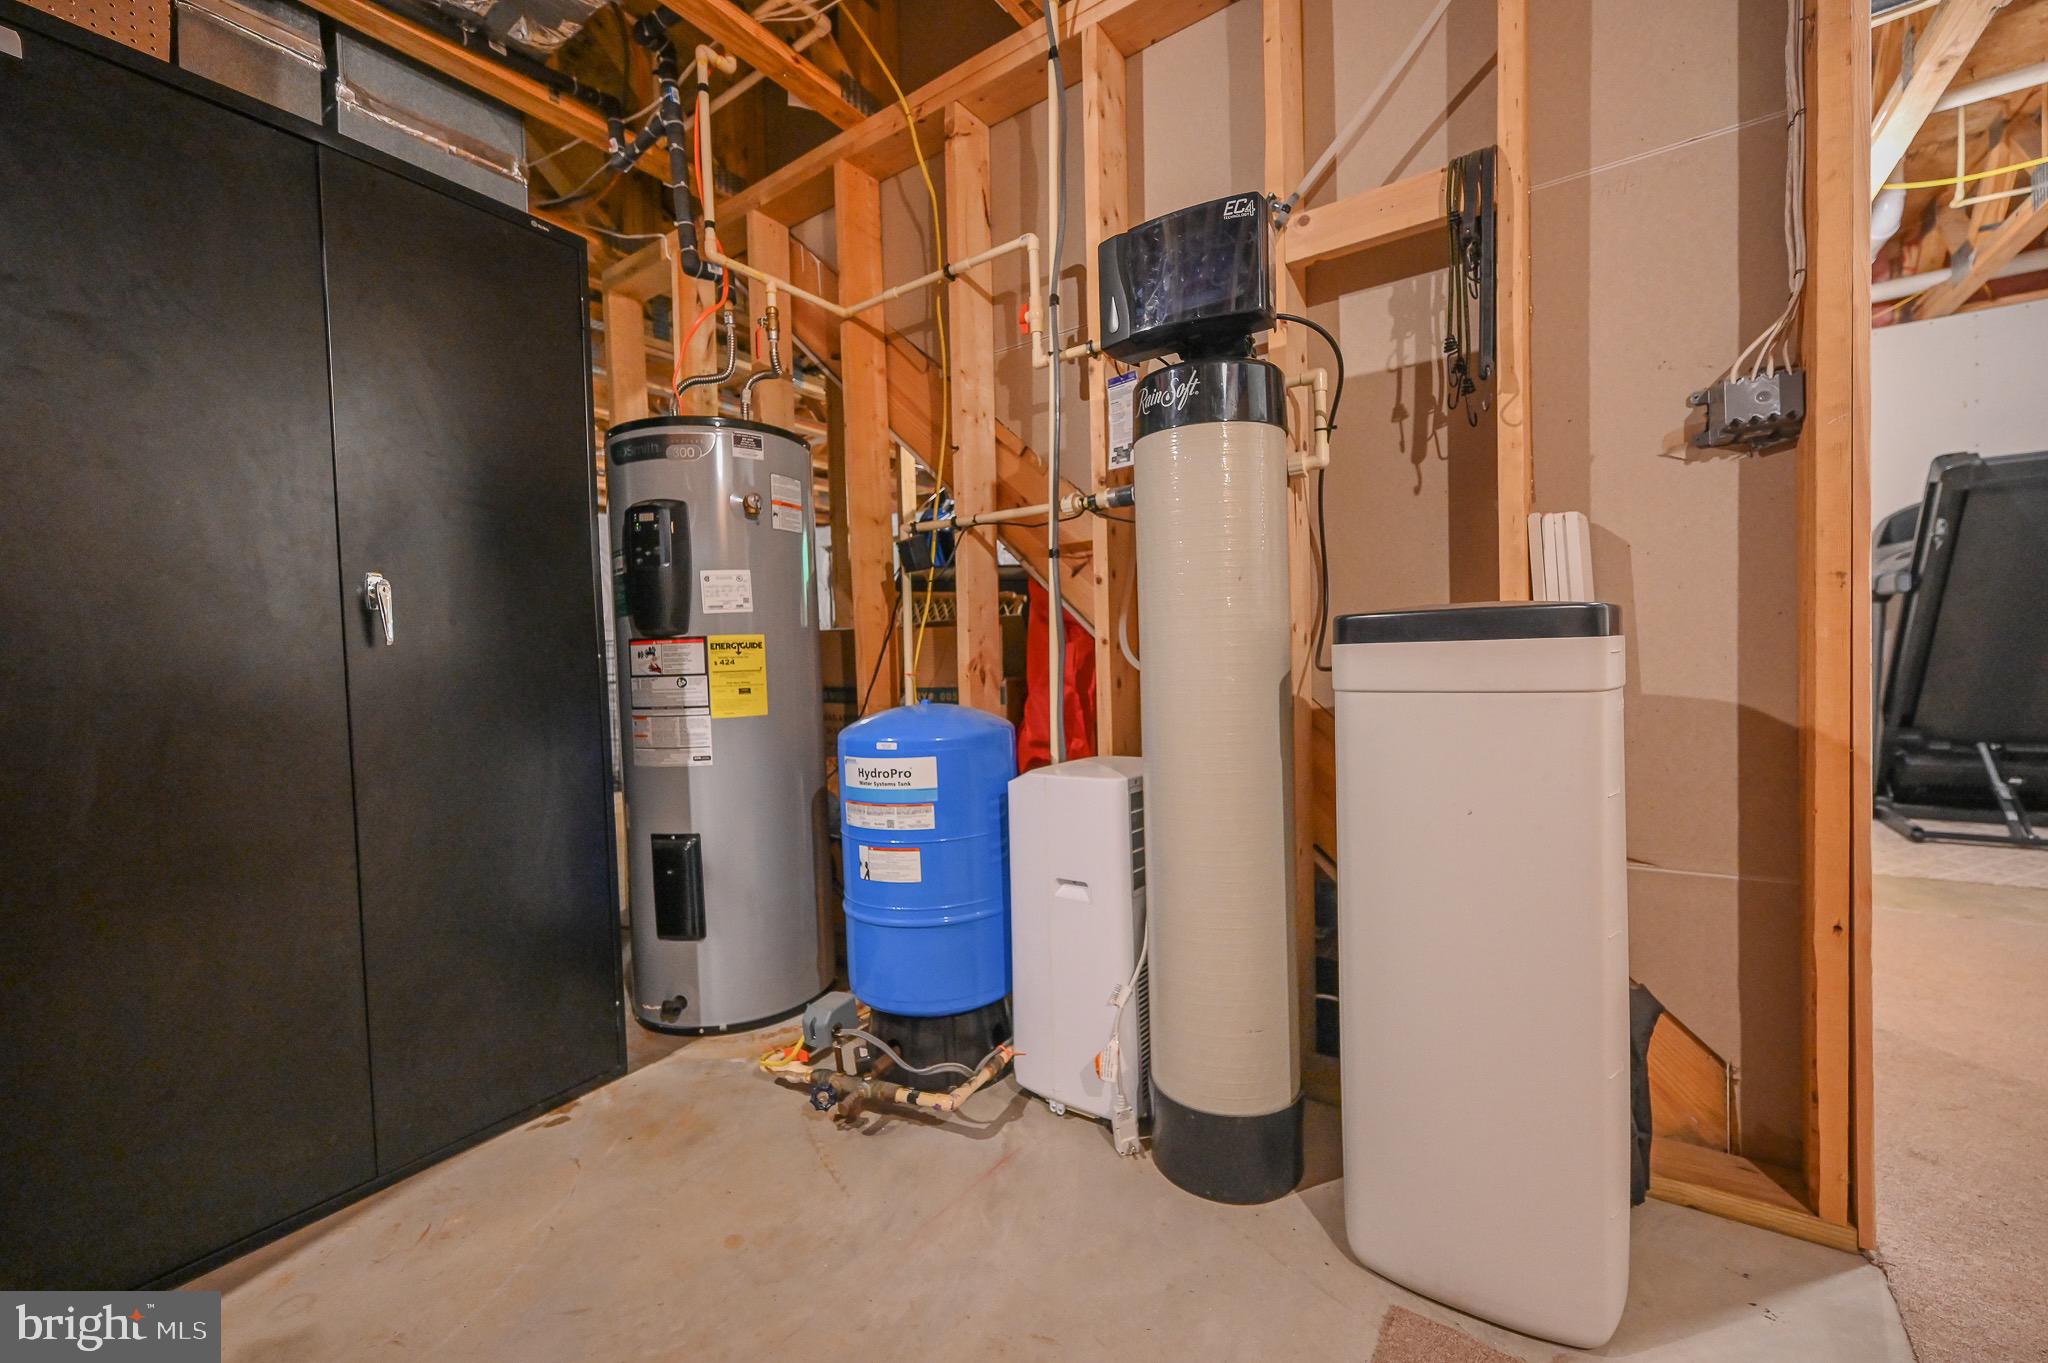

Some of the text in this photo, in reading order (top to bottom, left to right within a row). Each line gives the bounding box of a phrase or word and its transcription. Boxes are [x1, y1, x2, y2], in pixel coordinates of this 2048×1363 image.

[1223, 198, 1256, 217] EC4
[1136, 369, 1200, 418] RainSoft
[672, 446, 695, 459] 300
[857, 767, 912, 780] HydroPro
